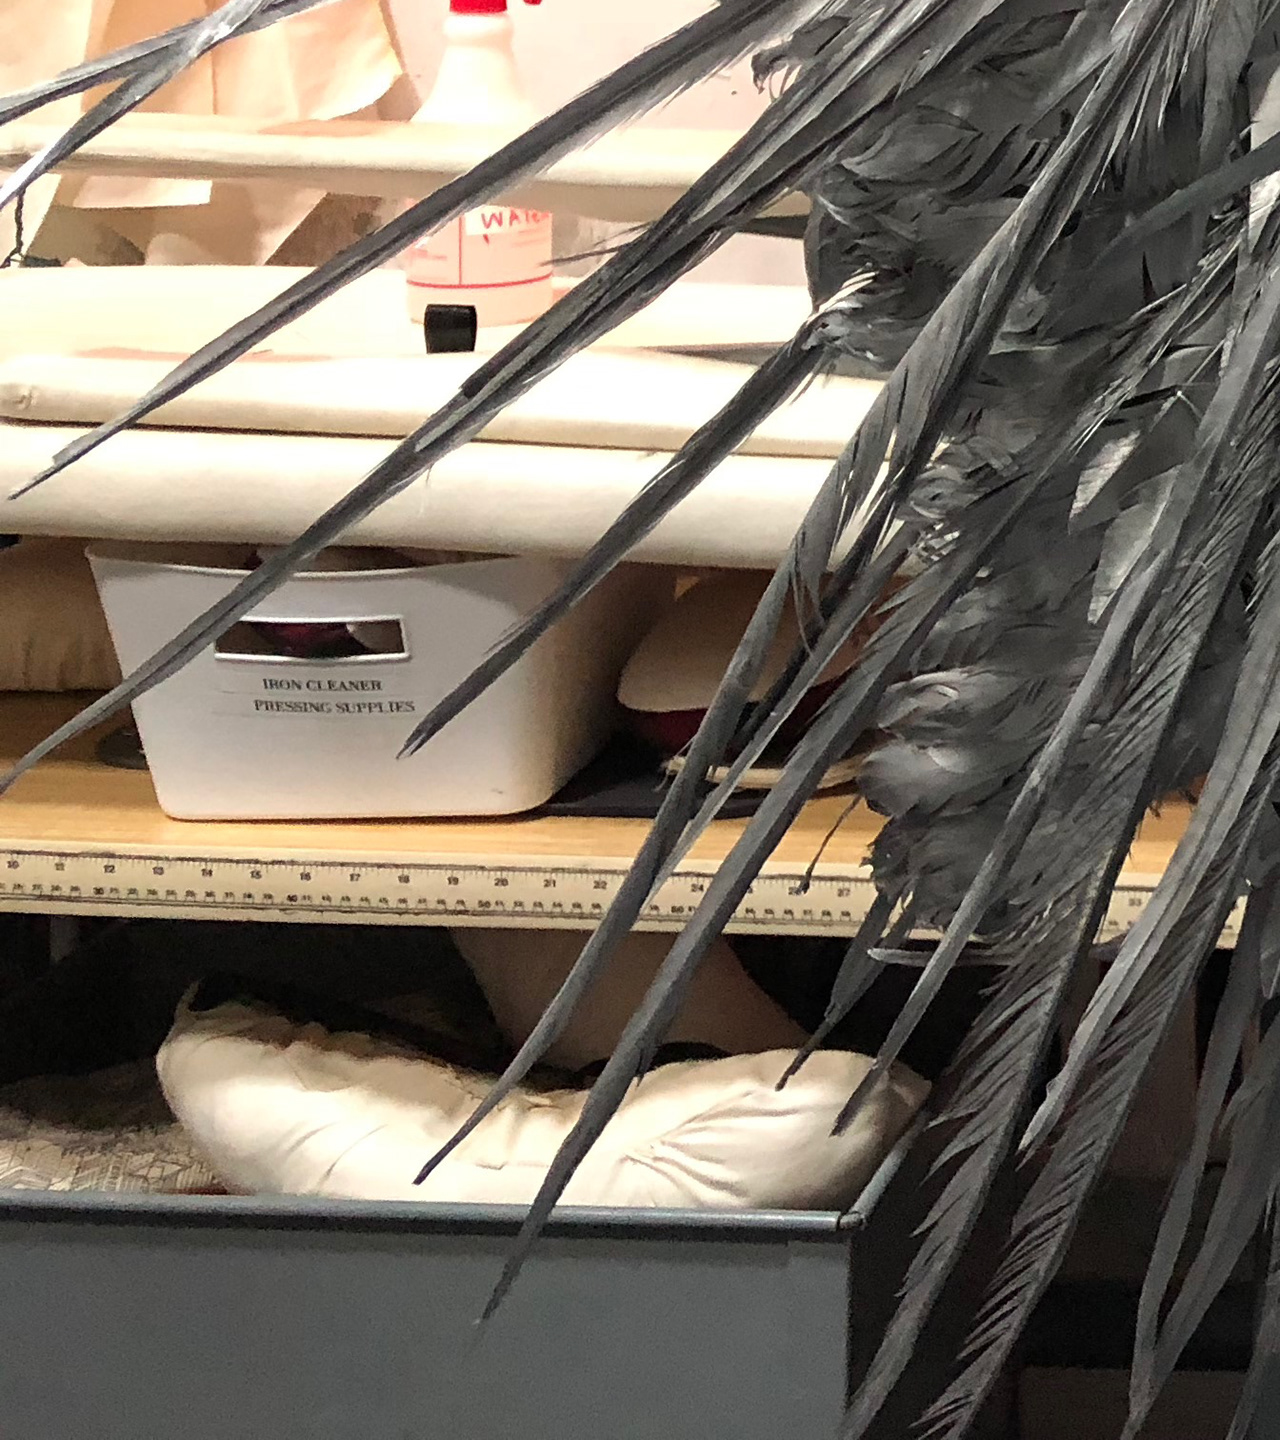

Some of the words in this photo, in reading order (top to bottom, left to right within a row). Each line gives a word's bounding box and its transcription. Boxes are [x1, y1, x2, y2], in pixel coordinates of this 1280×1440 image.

[262, 678, 301, 690] IRON
[306, 679, 383, 691] CLEANER
[254, 699, 332, 712] PRESSING
[335, 701, 416, 714] SUPPLIES
[104, 864, 115, 873] 12
[202, 868, 213, 877] 14
[250, 870, 262, 879] 15
[350, 873, 361, 882] 17
[447, 876, 459, 885] 19
[494, 878, 509, 886] 20
[543, 879, 556, 887] 21
[593, 880, 607, 889] 22
[691, 883, 704, 893] 24
[837, 888, 850, 897] 27
